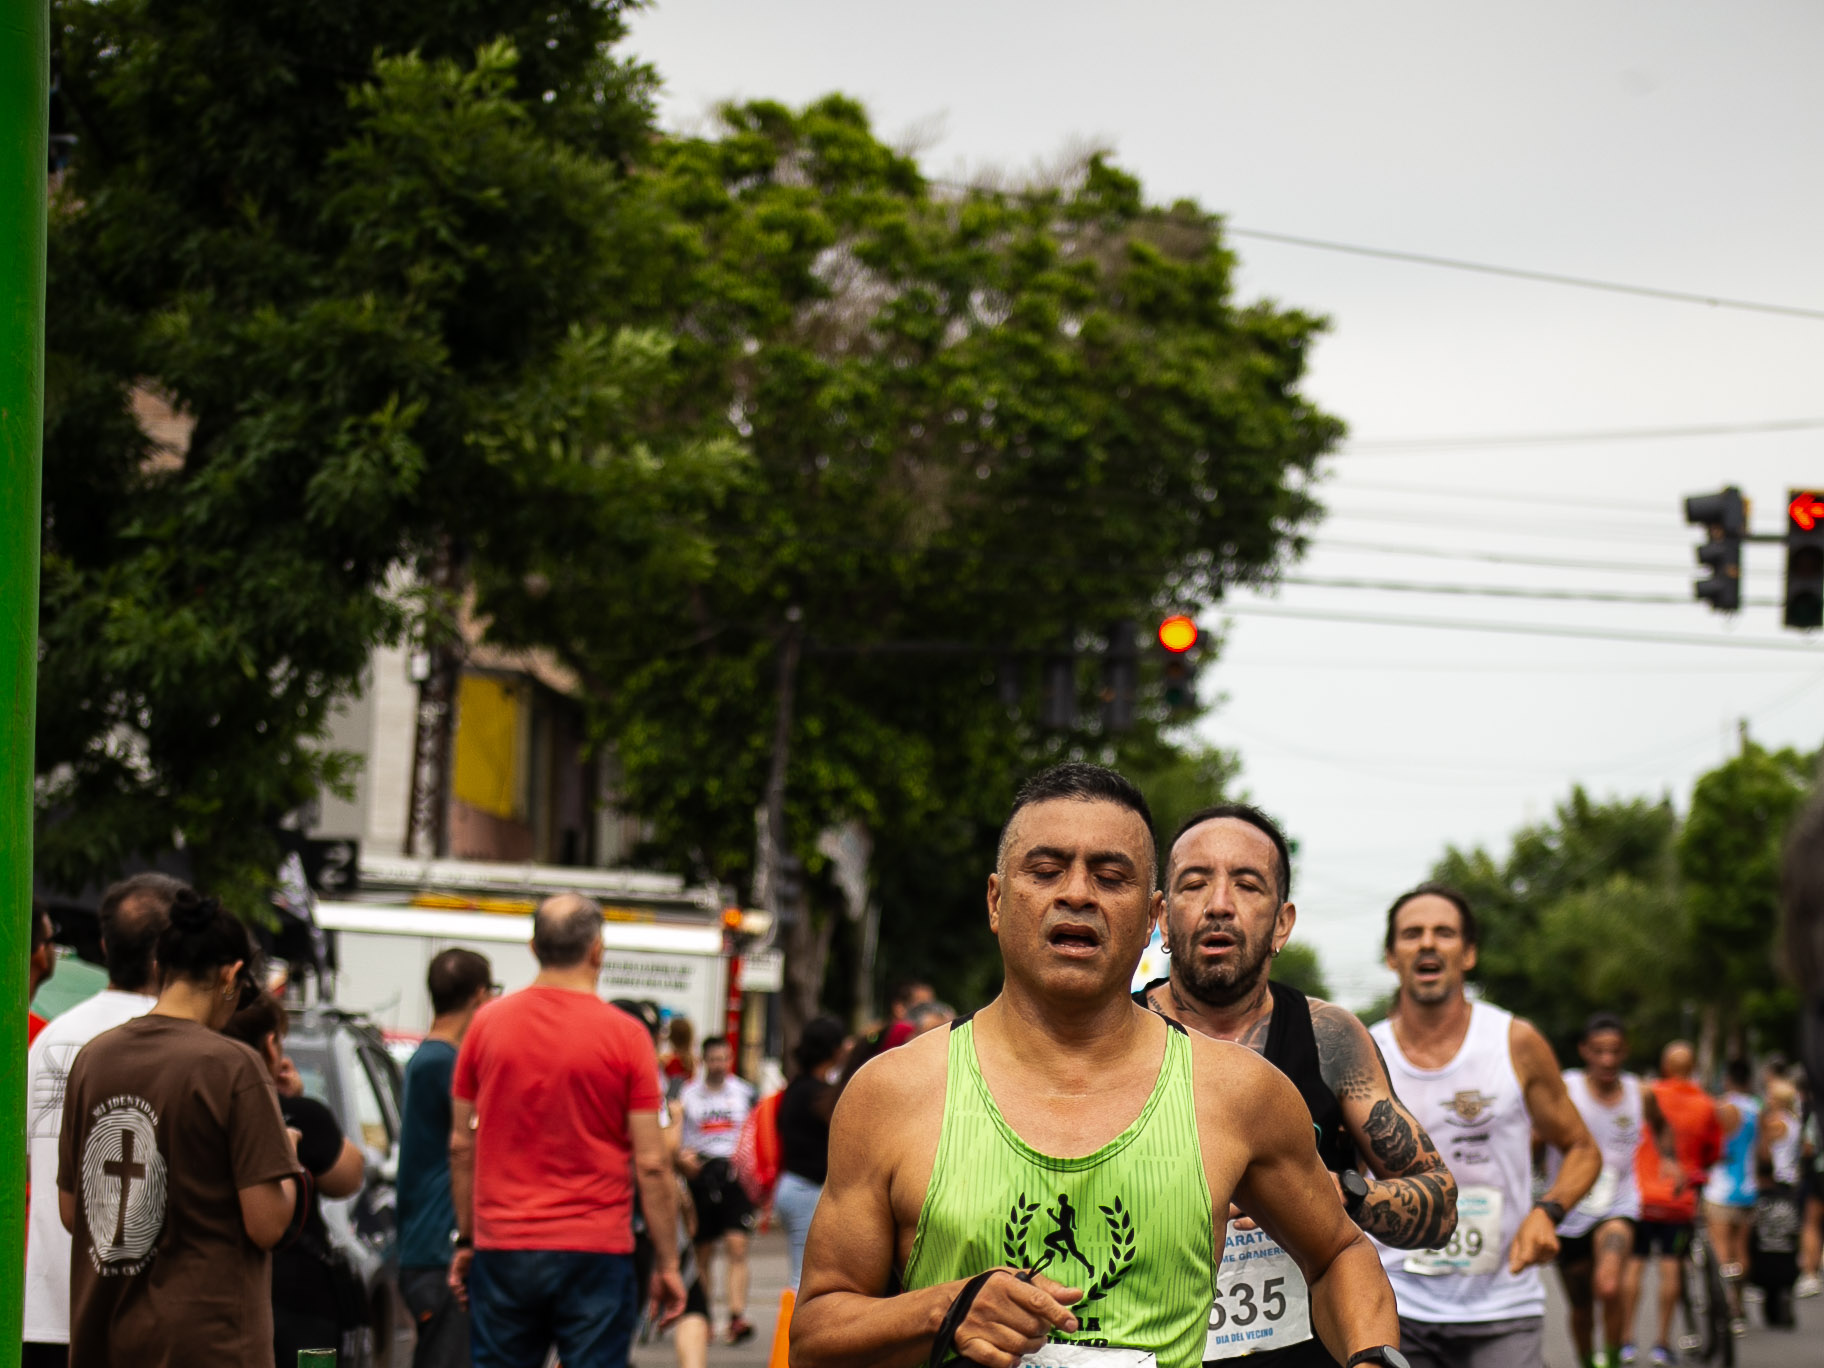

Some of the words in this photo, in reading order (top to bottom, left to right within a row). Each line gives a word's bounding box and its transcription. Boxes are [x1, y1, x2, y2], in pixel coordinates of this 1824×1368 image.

[107, 1095, 159, 1126] IDENTIDAD
[1216, 1334, 1229, 1345] DIA
[1231, 1332, 1244, 1343] DEL
[1246, 1327, 1273, 1340] VECINO
